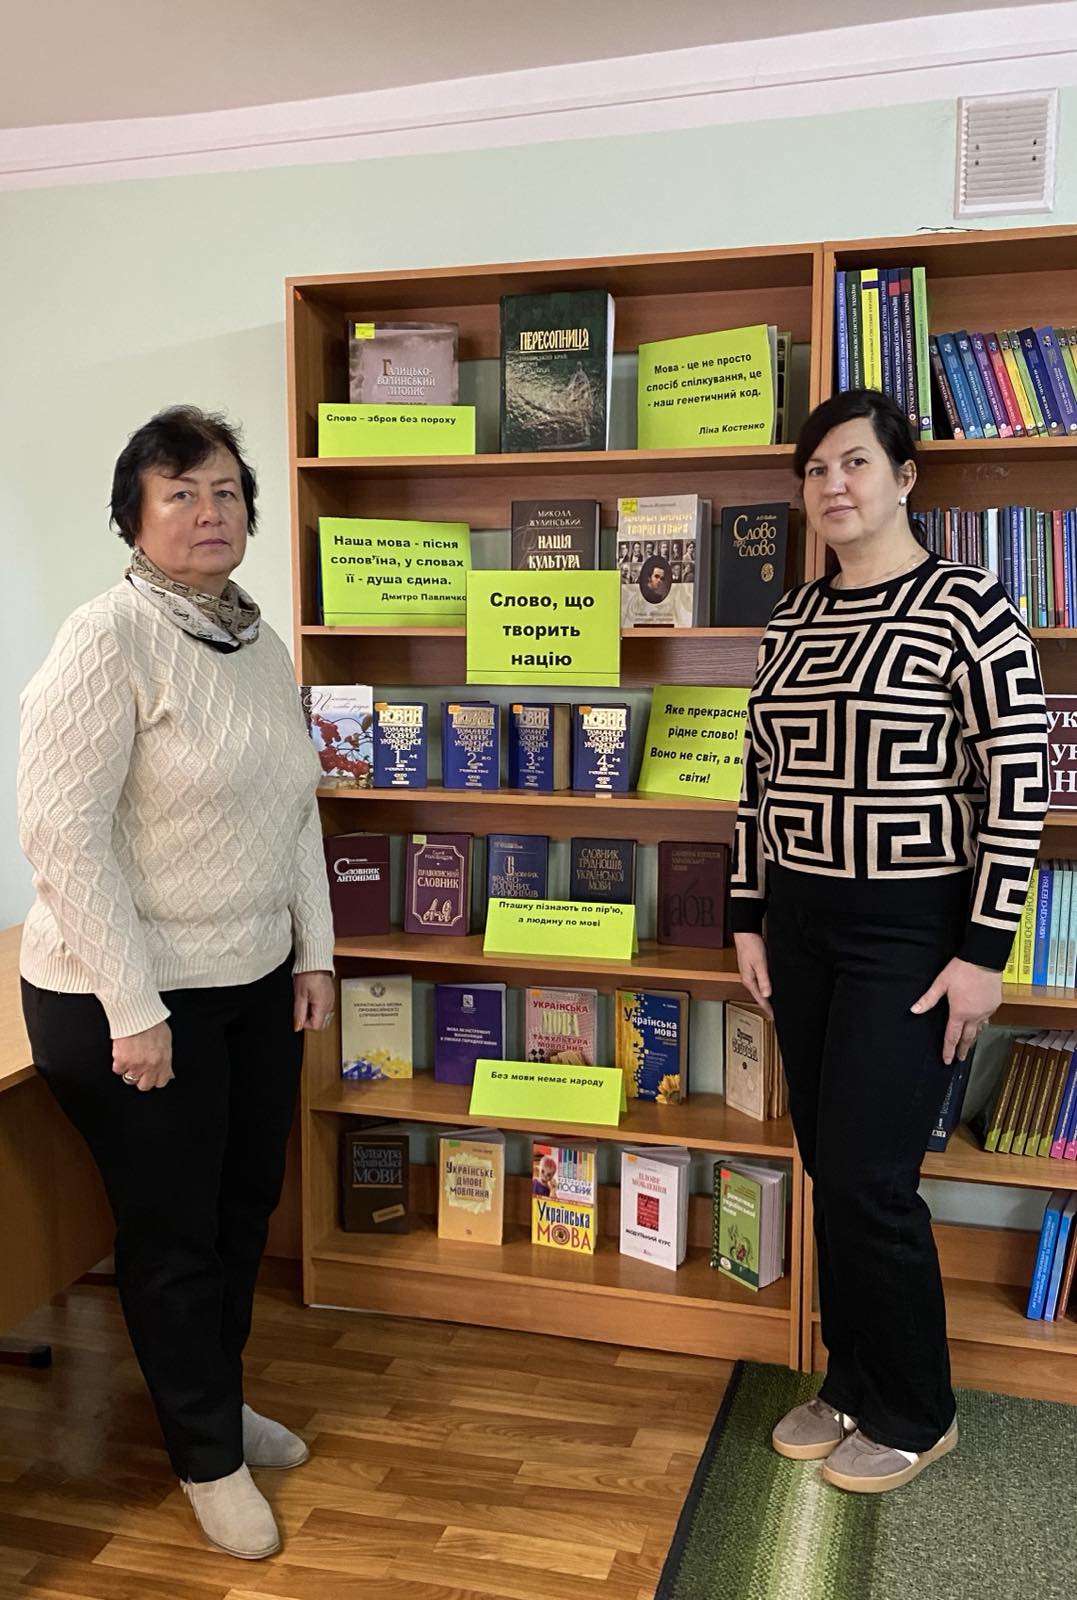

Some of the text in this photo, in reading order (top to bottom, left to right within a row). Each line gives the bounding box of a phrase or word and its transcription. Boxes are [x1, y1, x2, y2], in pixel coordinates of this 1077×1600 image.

[520, 328, 589, 350] ПЕРЕСОПНИЦЯ
[654, 354, 752, 374] Мова це не просто
[377, 376, 436, 386] ВОЛИНСЬКИЙ
[646, 370, 762, 392] спосіб спілкування, це
[388, 386, 425, 396] ЛІТОПИС
[654, 388, 761, 408] наш генетичний код.
[326, 414, 456, 425] Слово зброя без пороху
[699, 422, 766, 434] Ліна Костенко
[538, 510, 572, 518] МИКОЛА
[334, 536, 458, 548] Наша мова пісня
[538, 534, 572, 550] НАЦІЯ
[404, 558, 412, 568] у
[416, 558, 464, 567] словах
[528, 554, 580, 570] КУЛЬТУРА
[346, 574, 452, 586] її душа єдина.
[382, 593, 467, 602] Дмитро Павличко
[490, 592, 595, 610] Слово, що
[502, 625, 580, 640] творить
[512, 652, 572, 668] націю
[664, 704, 748, 719] Яке прекрасне
[668, 726, 738, 740] рідне слово!
[394, 750, 400, 764] 1
[467, 752, 477, 766] 2
[526, 752, 534, 766] 3
[596, 754, 608, 767] 4
[650, 747, 676, 759] Воно
[680, 752, 693, 760] не
[696, 752, 720, 765] світ,
[679, 772, 711, 784] світи!
[336, 874, 380, 883] АНТОНІМІВ
[418, 878, 460, 889] СЛОВНИК
[499, 902, 534, 910] Пташку
[536, 904, 579, 912] пізнають
[526, 918, 563, 926] людину
[543, 1010, 580, 1037] МОВА
[624, 1007, 677, 1030] Українська
[654, 1028, 677, 1038] мова
[491, 1072, 508, 1080] Без
[538, 1076, 568, 1084] немає
[570, 1078, 604, 1088] народу
[354, 1168, 402, 1183] МОВИ
[537, 1200, 590, 1228] Українська
[537, 1221, 591, 1250] МОВА
